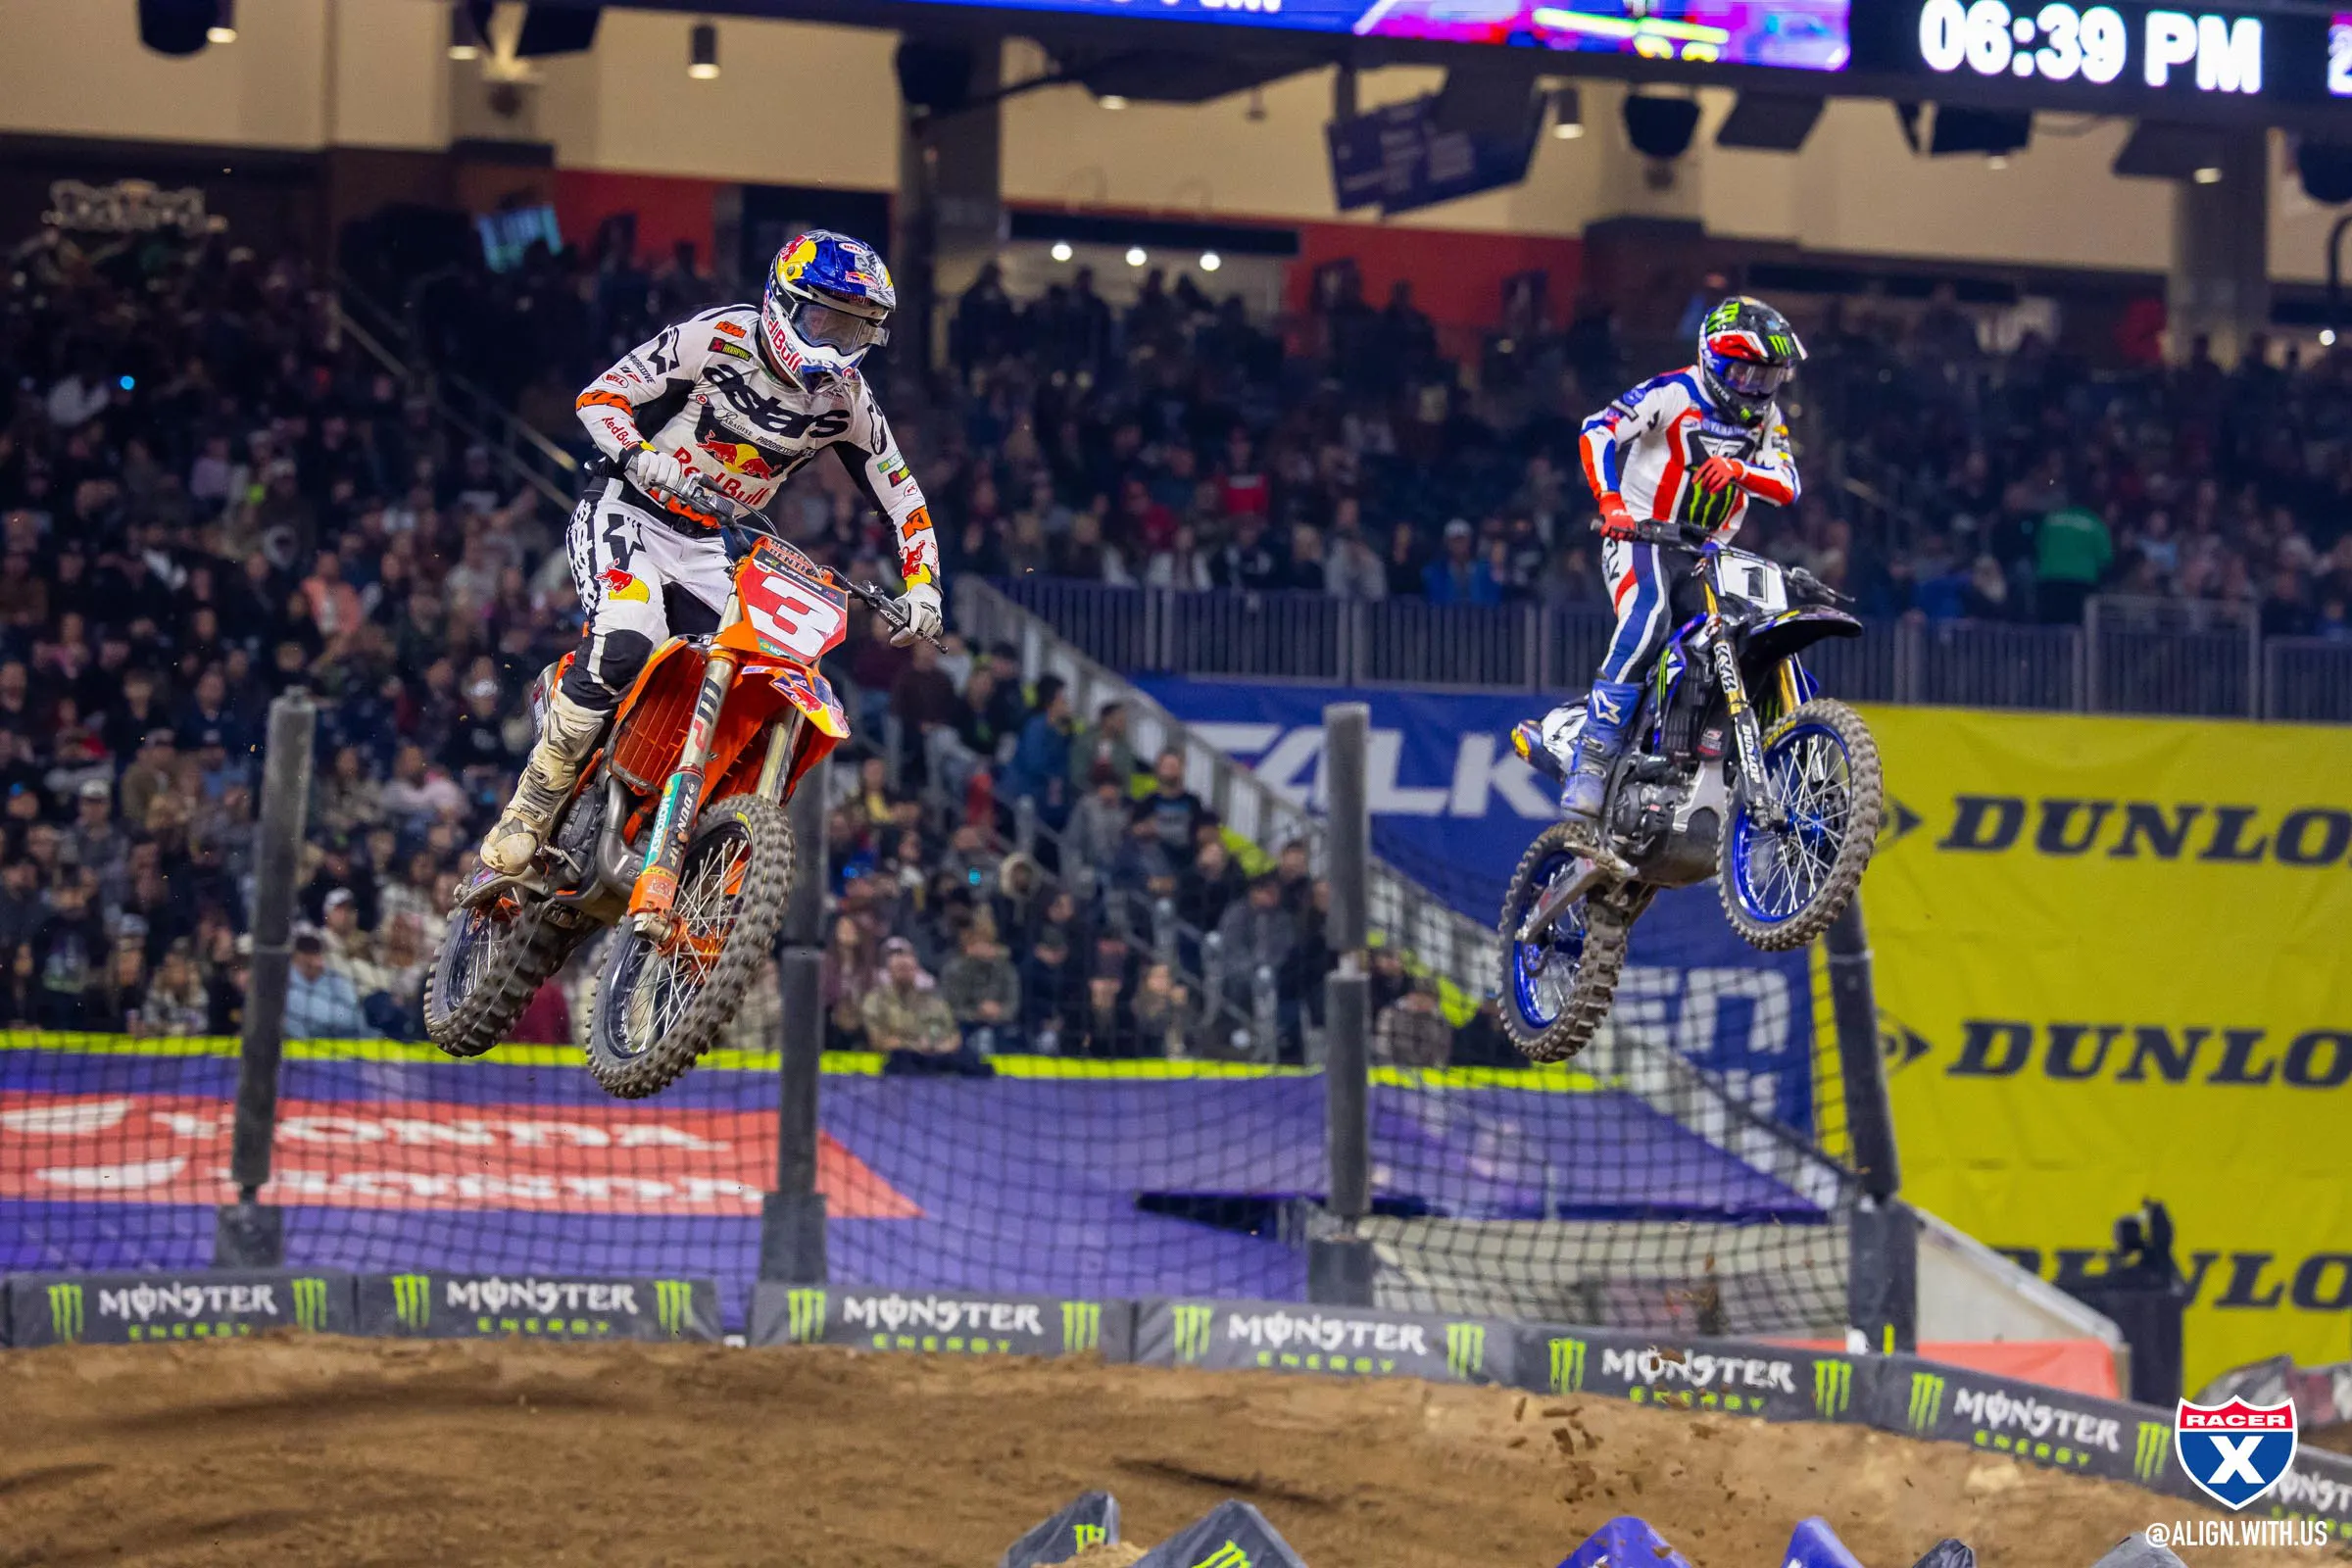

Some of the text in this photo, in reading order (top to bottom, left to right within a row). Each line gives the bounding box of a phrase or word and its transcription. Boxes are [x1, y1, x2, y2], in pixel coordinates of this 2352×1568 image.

[1918, 0, 2263, 94] 06:39 PM
[713, 320, 747, 339] KTM
[605, 373, 625, 387] BELL
[1741, 565, 1769, 604] 1
[747, 574, 841, 659] 3
[1741, 723, 1761, 784] DUNLOP
[649, 796, 671, 854] MOTOREX
[1936, 794, 2352, 869] DUNLO
[1945, 1018, 2352, 1091] DUNLO
[99, 1281, 278, 1321] MONSTER
[447, 1276, 640, 1315] MONSTER
[843, 1292, 1044, 1336] MONSTER
[1227, 1309, 1429, 1357] MONSTER
[1600, 1343, 1798, 1395] MONSTER
[1953, 1385, 2122, 1454] MONSTER
